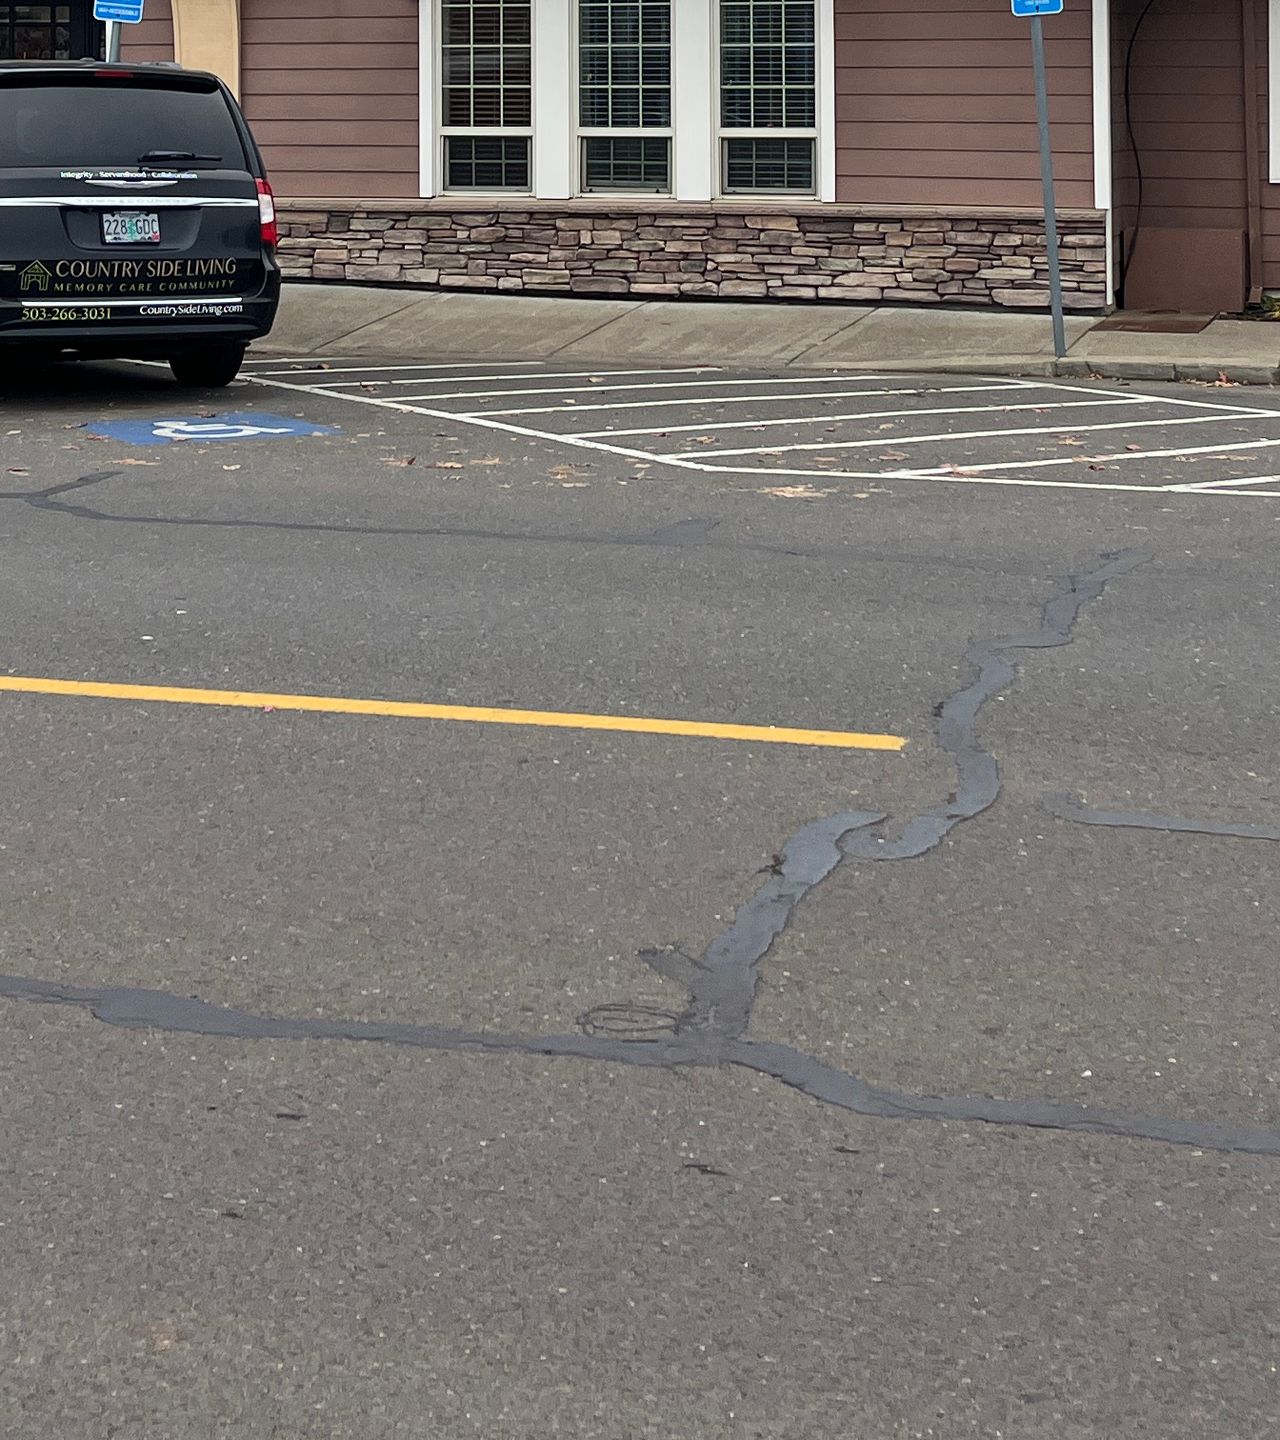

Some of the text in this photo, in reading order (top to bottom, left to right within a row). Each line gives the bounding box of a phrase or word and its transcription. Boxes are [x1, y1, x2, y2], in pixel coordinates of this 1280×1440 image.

[60, 171, 94, 179] Integrity
[100, 171, 147, 179] Servanthood
[104, 218, 159, 236] 228 GDC
[55, 257, 237, 278] COUNTRY SIDE LIVING
[53, 279, 236, 293] MEMORY CARE COMMUNITY
[21, 304, 243, 321] 503-266-3031 CountrySideLiving.com
